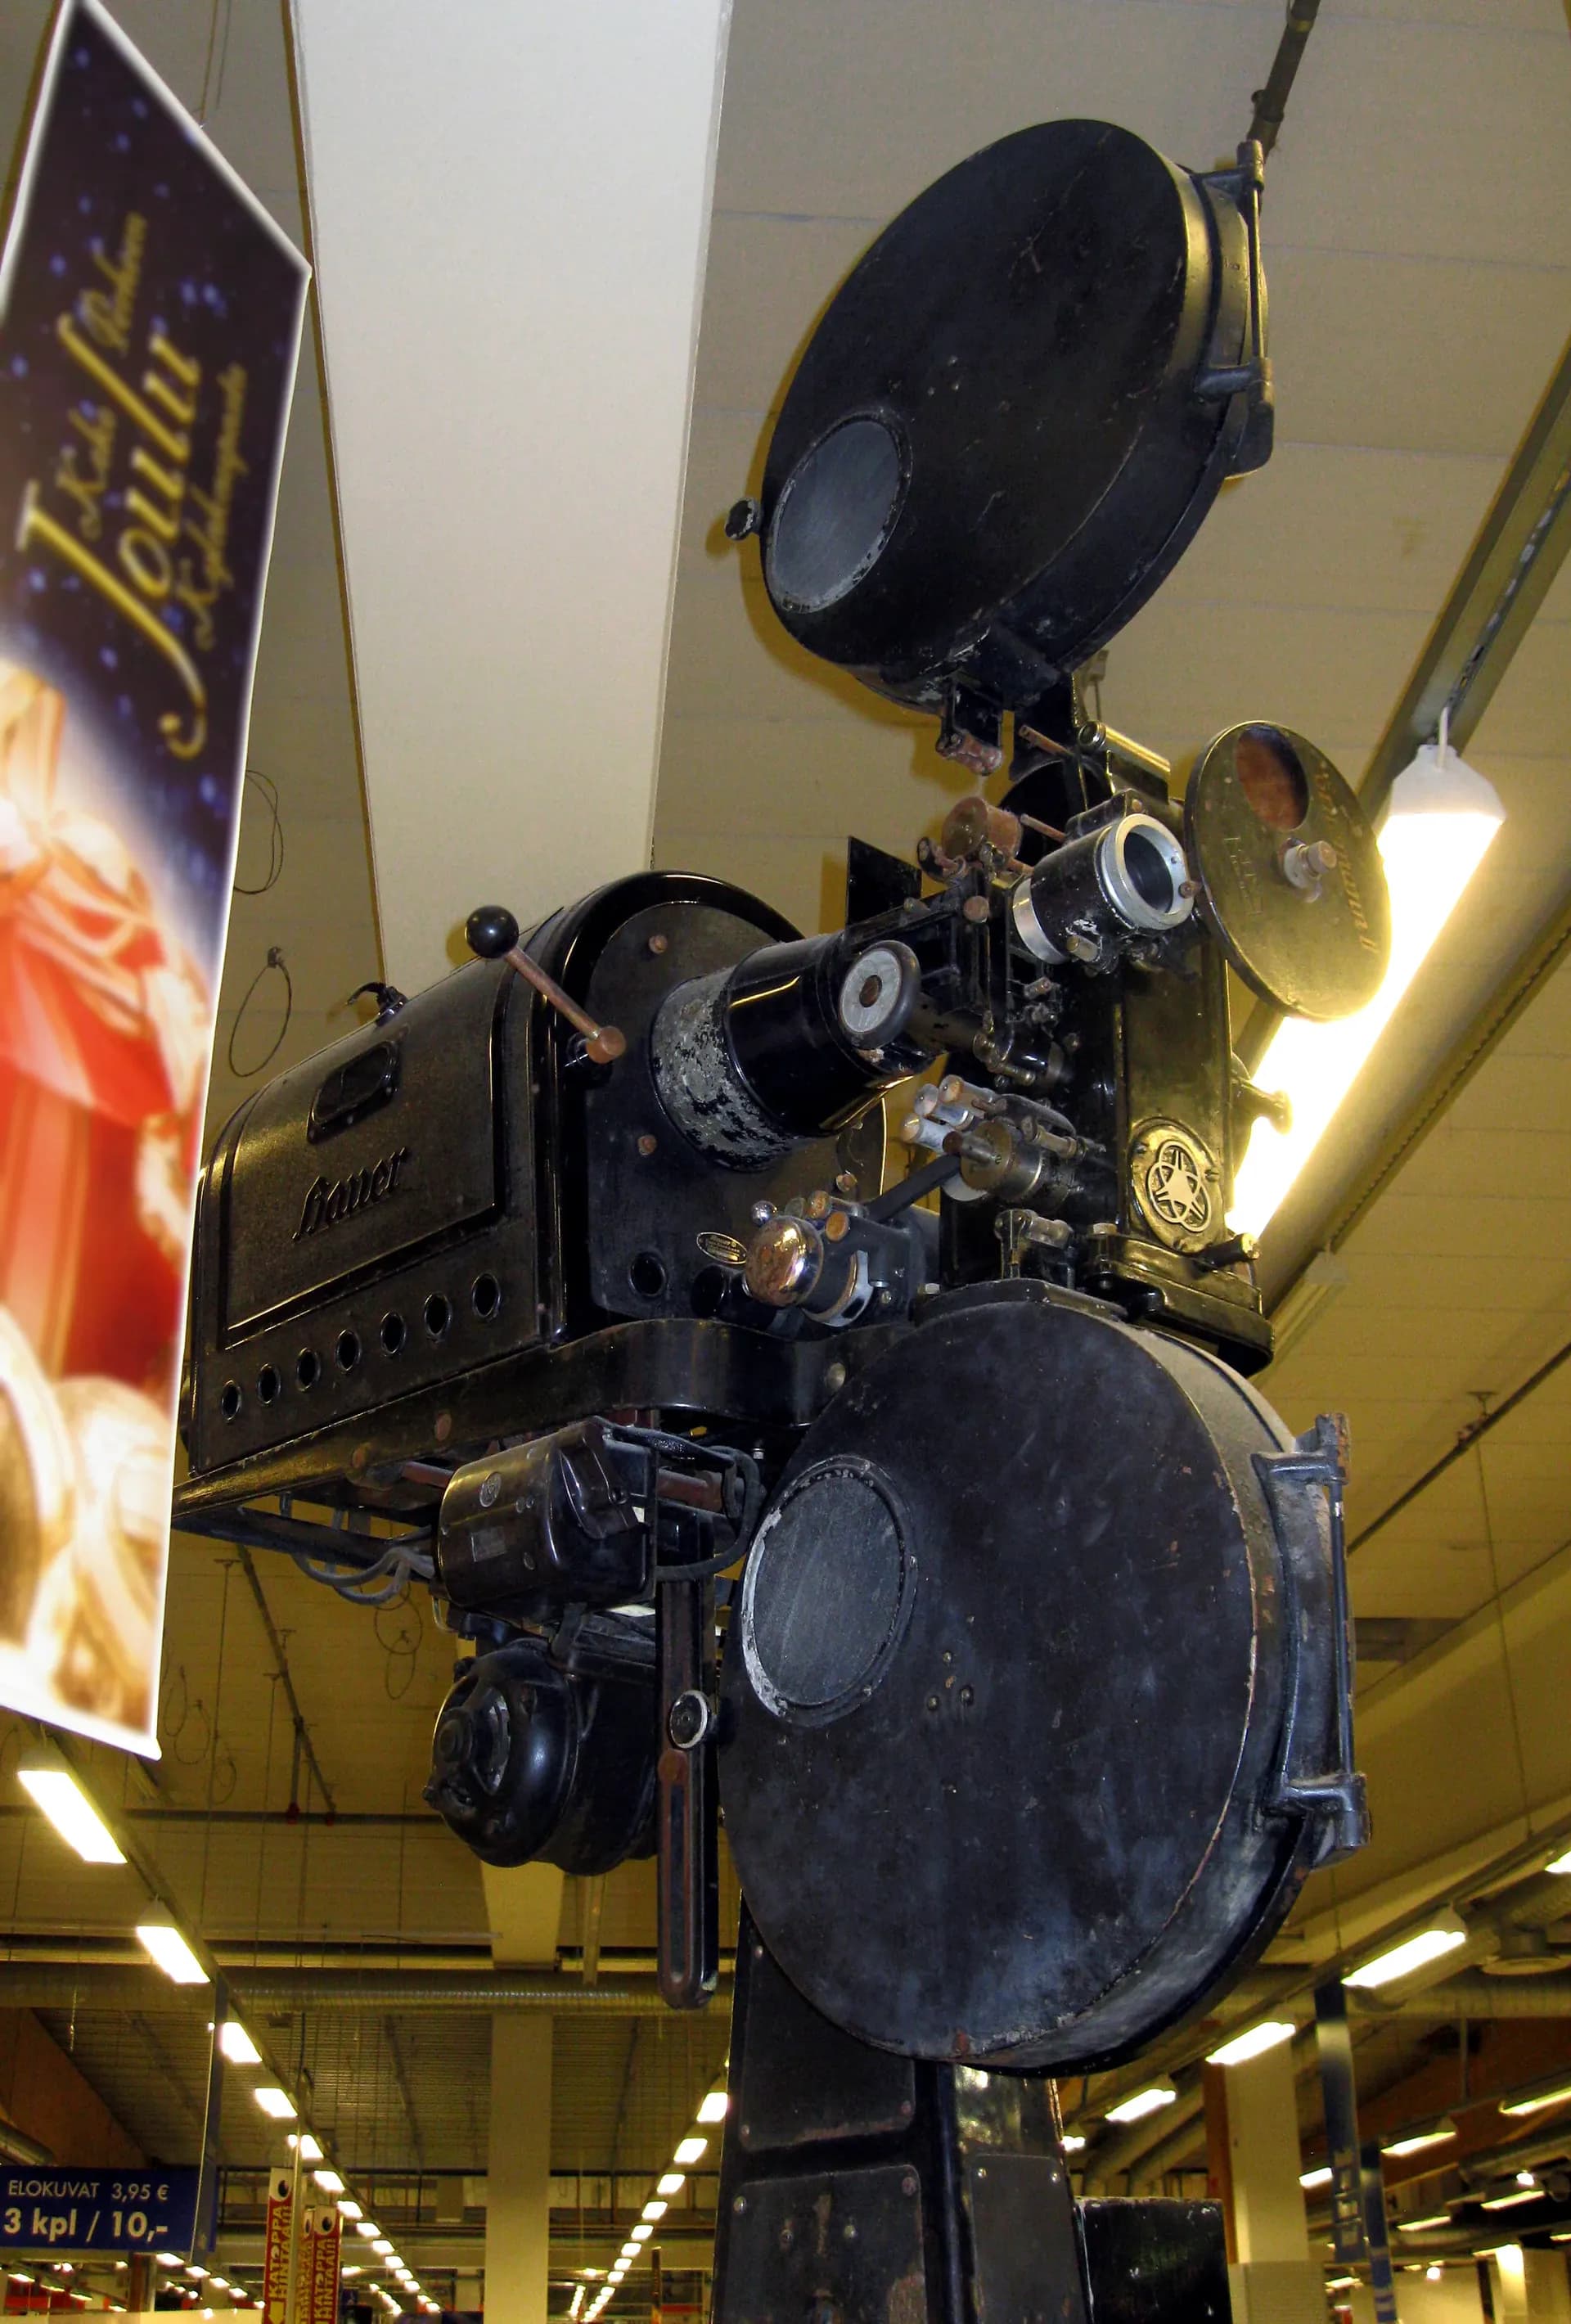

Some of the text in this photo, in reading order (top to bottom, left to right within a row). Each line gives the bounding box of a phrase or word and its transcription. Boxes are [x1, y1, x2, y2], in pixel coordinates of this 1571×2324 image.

[16, 312, 207, 760] Joulu
[8, 2180, 169, 2202] ELOKUVAT 3,95 €
[4, 2208, 168, 2242] 3 kpl / 10,-
